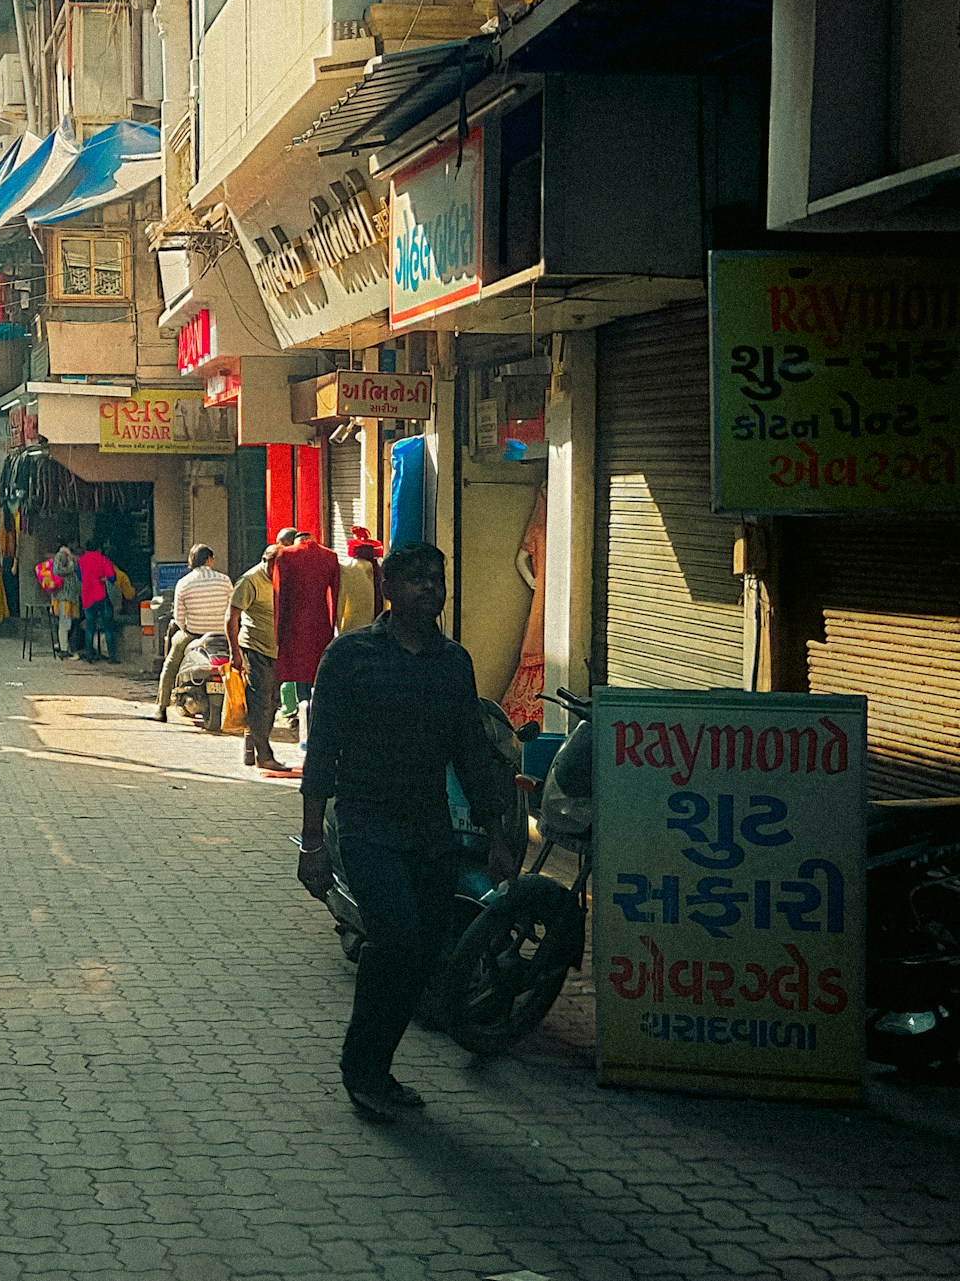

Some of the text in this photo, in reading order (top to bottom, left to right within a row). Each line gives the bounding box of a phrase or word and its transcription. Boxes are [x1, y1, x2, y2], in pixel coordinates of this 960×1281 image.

[768, 283, 960, 350] Raymon
[342, 378, 428, 403] અભિનેત્રી
[122, 425, 171, 440] AVSAR
[612, 858, 845, 939] સફારી
[608, 935, 849, 1016] એવરગ્લેડ
